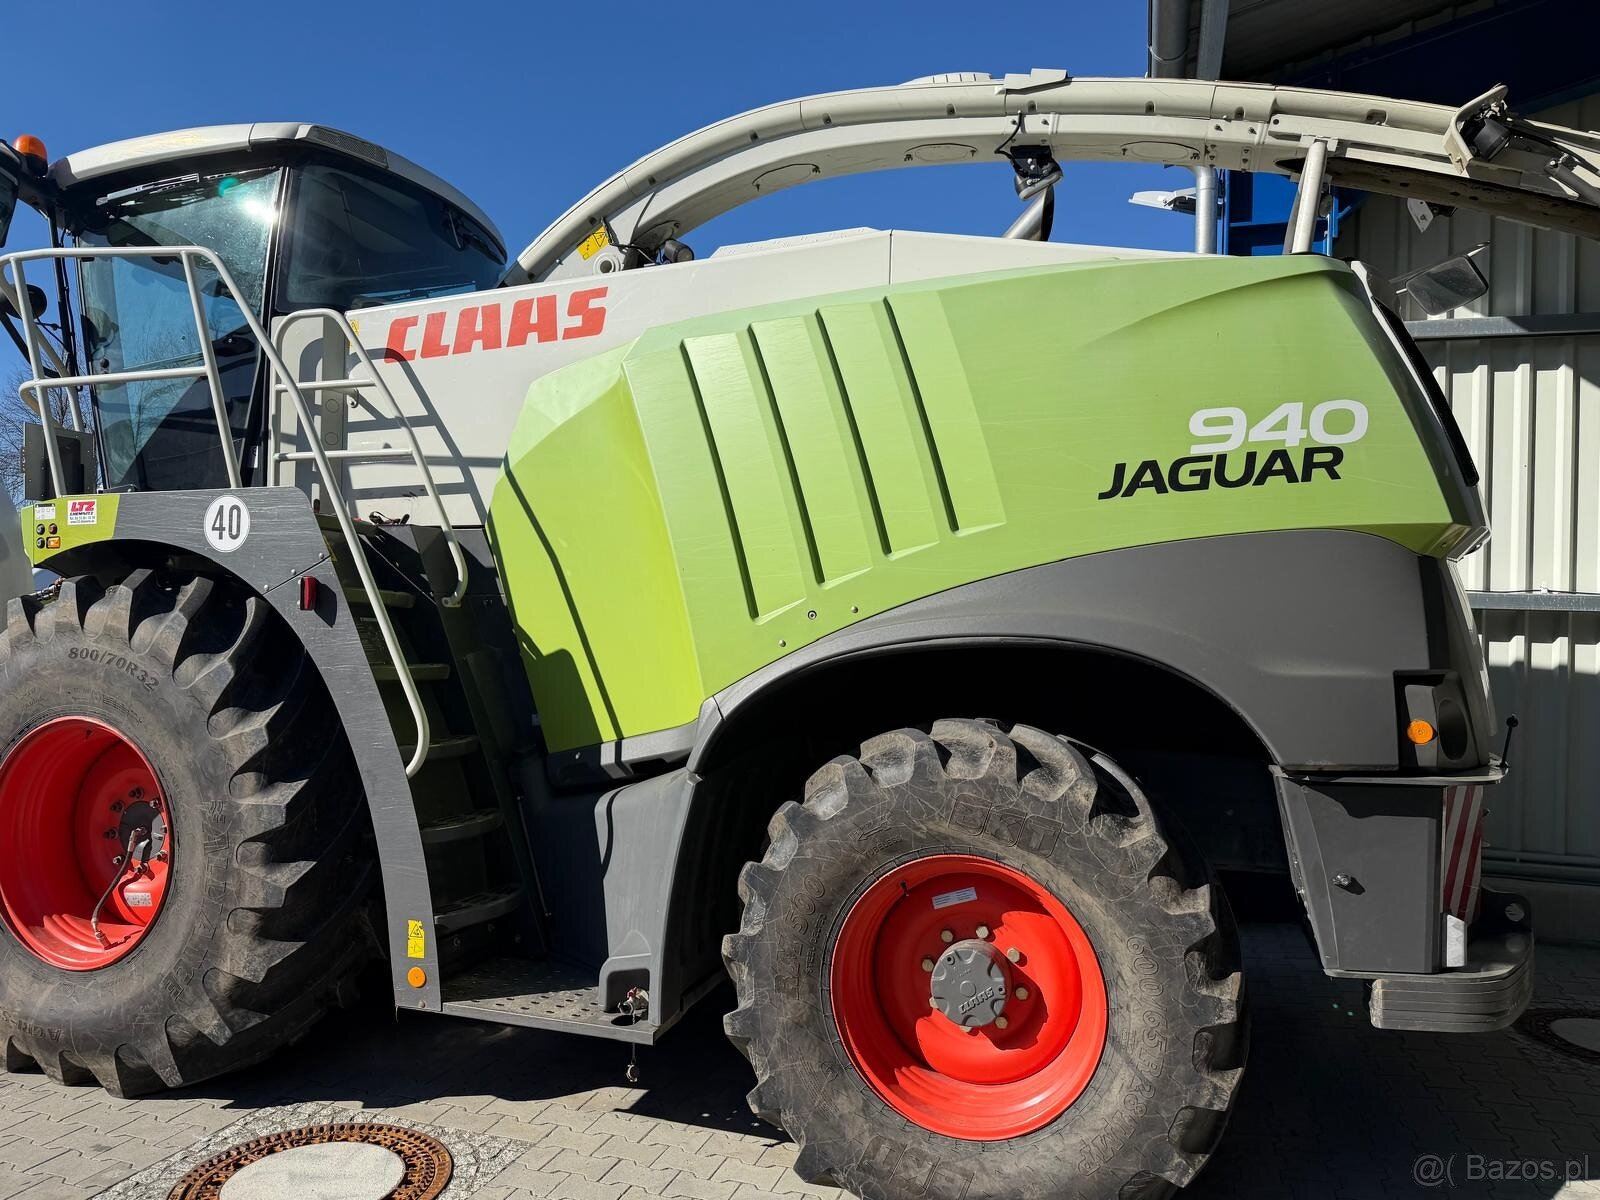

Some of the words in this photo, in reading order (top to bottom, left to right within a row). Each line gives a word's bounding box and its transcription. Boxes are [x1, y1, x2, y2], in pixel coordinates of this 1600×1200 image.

[384, 287, 607, 363] CLAAS
[1189, 399, 1369, 454] 940
[1098, 446, 1344, 500] JAGUAR
[71, 500, 95, 512] LTZ
[212, 504, 241, 540] 40
[68, 647, 160, 693] 800/70R32
[947, 793, 1065, 859] BKT
[958, 986, 995, 1015] CLAAS
